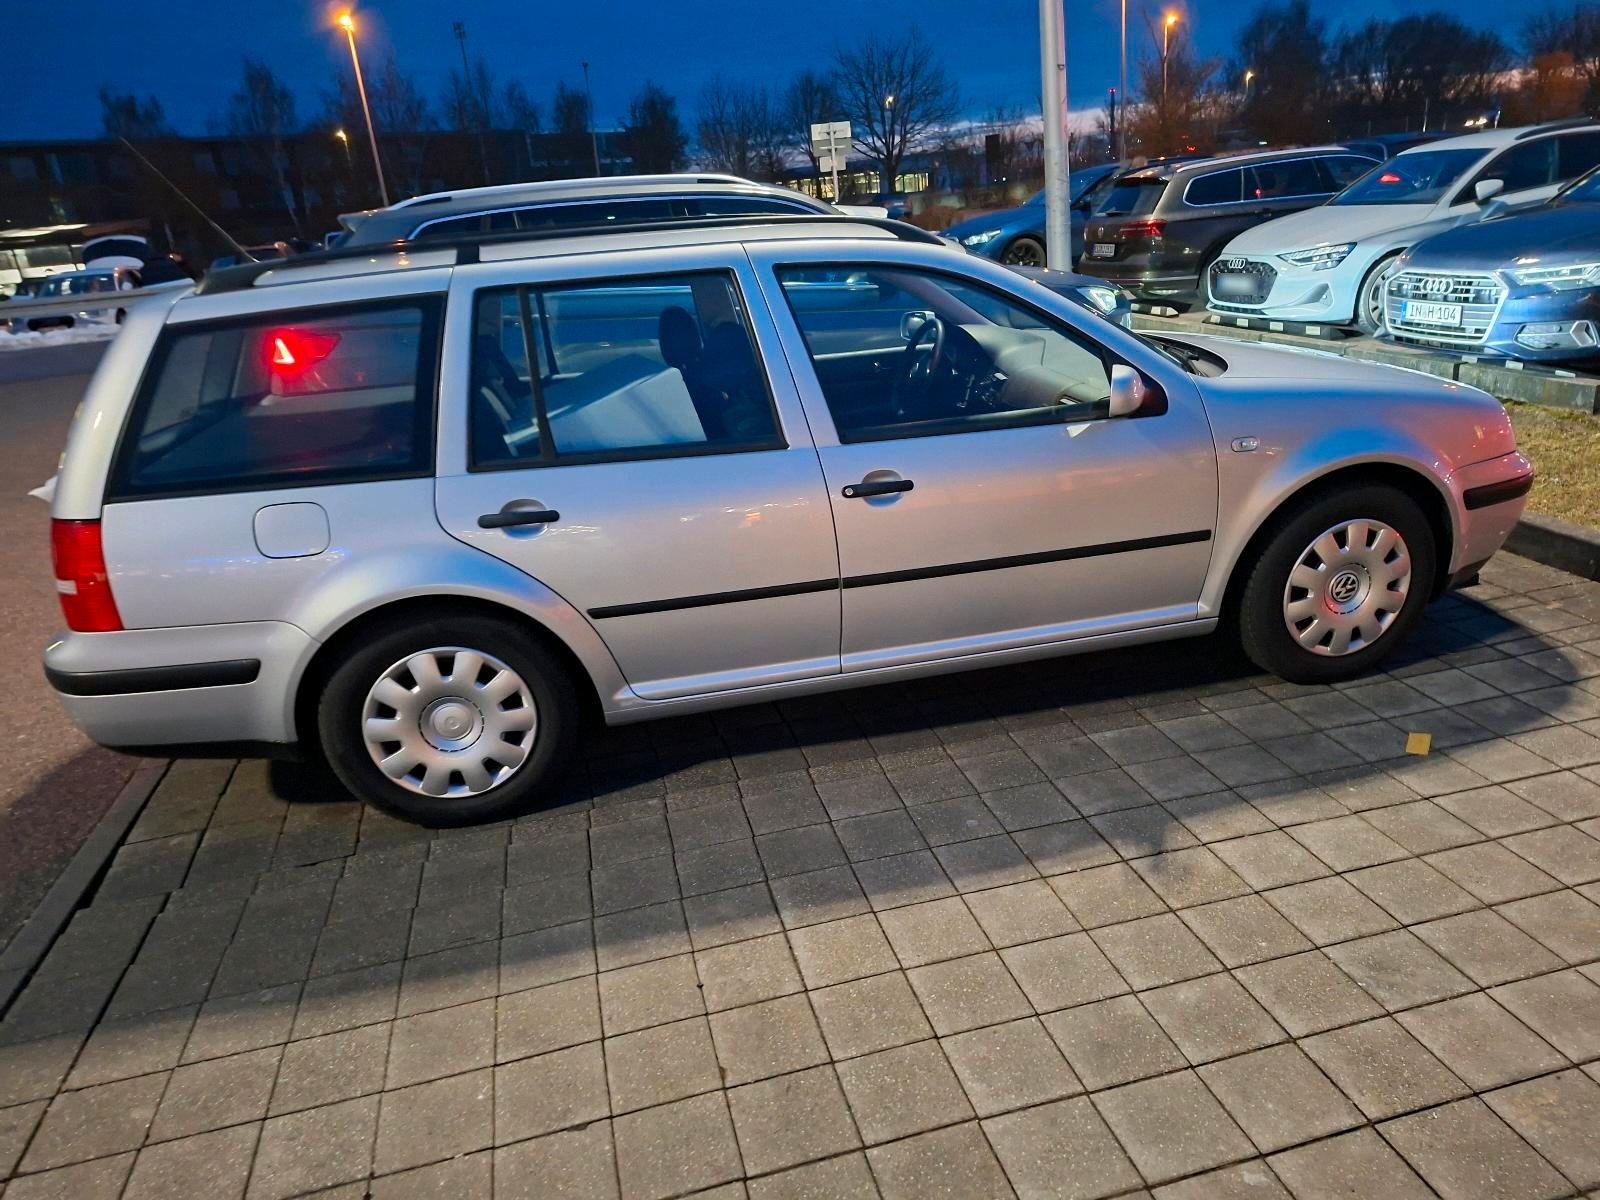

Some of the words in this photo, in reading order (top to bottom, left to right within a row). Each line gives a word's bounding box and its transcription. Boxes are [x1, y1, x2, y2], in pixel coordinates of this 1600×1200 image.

[1409, 304, 1422, 317] IN
[1427, 305, 1435, 319] H
[1437, 306, 1456, 321] 104
